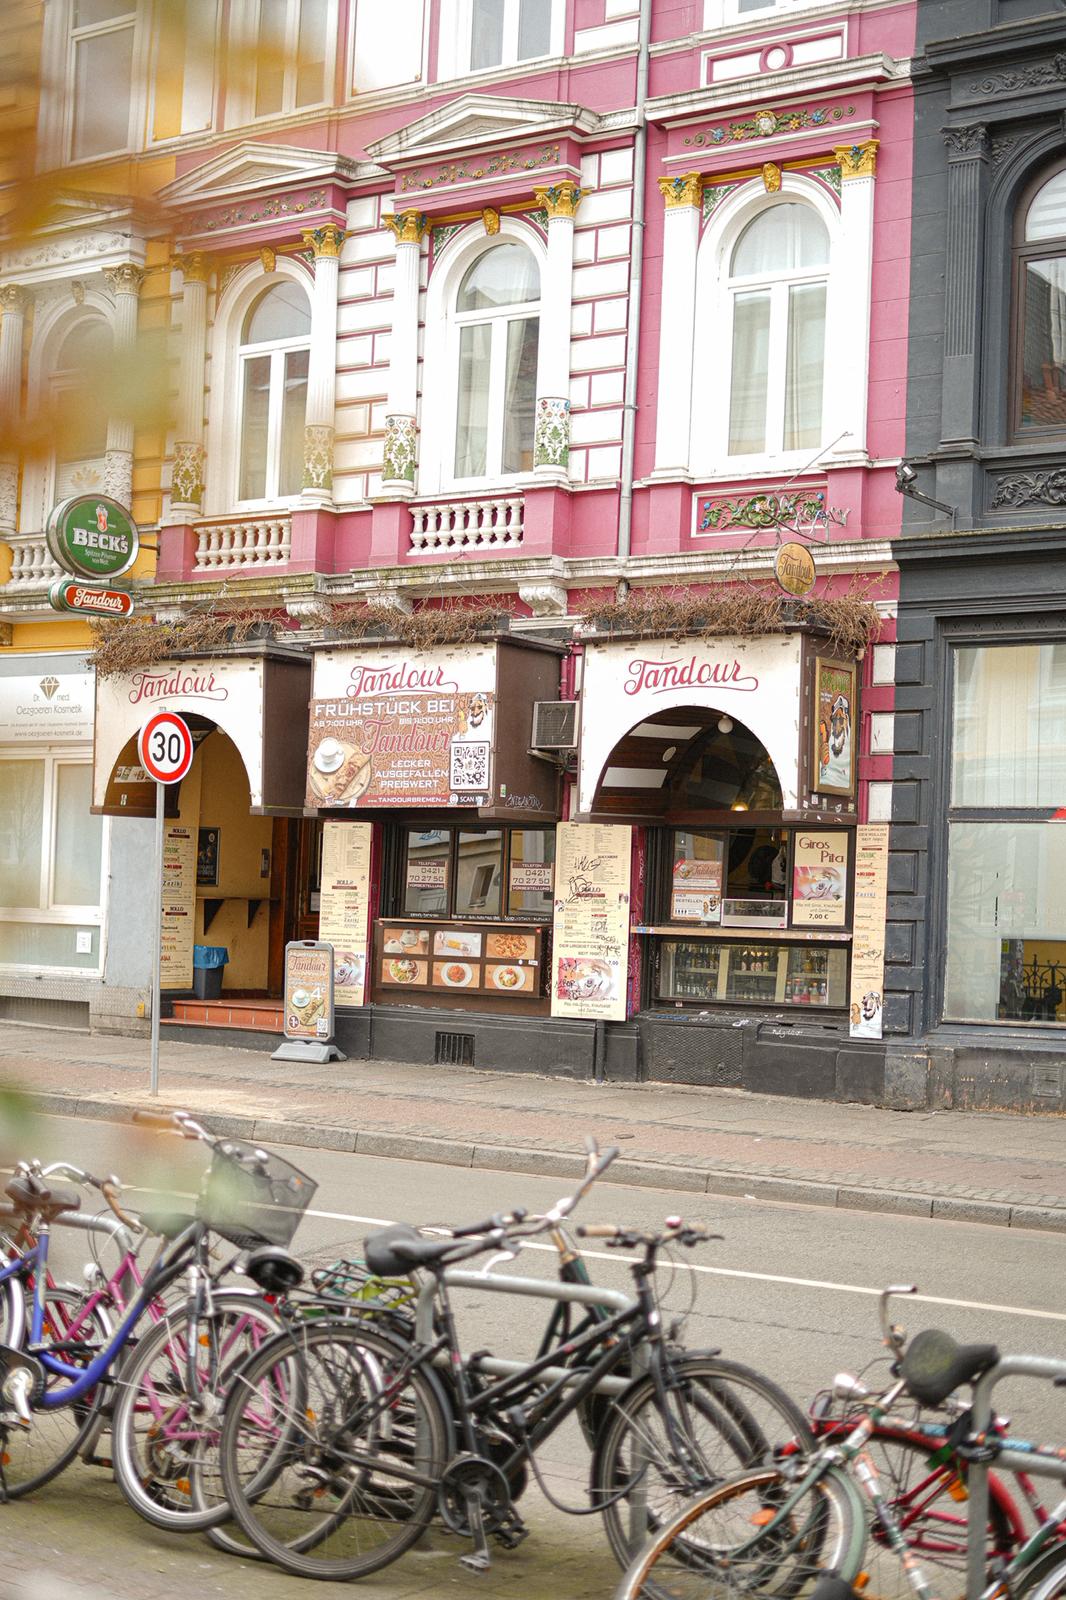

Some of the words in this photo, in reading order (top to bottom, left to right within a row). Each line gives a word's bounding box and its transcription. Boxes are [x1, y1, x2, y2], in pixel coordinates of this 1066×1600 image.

[780, 552, 813, 584] Tandour
[73, 588, 123, 611] Tandour
[346, 663, 458, 697] Tandour
[624, 656, 758, 695] Tandour
[128, 670, 228, 704] Tandour
[315, 697, 421, 717] FRÜHSTÜCK
[427, 700, 455, 713] BEI
[314, 720, 325, 728] AB
[436, 716, 454, 724] UHR
[152, 731, 181, 764] 30
[361, 719, 450, 755] Tandour
[375, 769, 449, 779] AUSGEFALLEN
[391, 759, 431, 768] LECKER
[380, 779, 439, 789] PREISWERT
[799, 837, 830, 850] Giros
[820, 850, 844, 863] Pita
